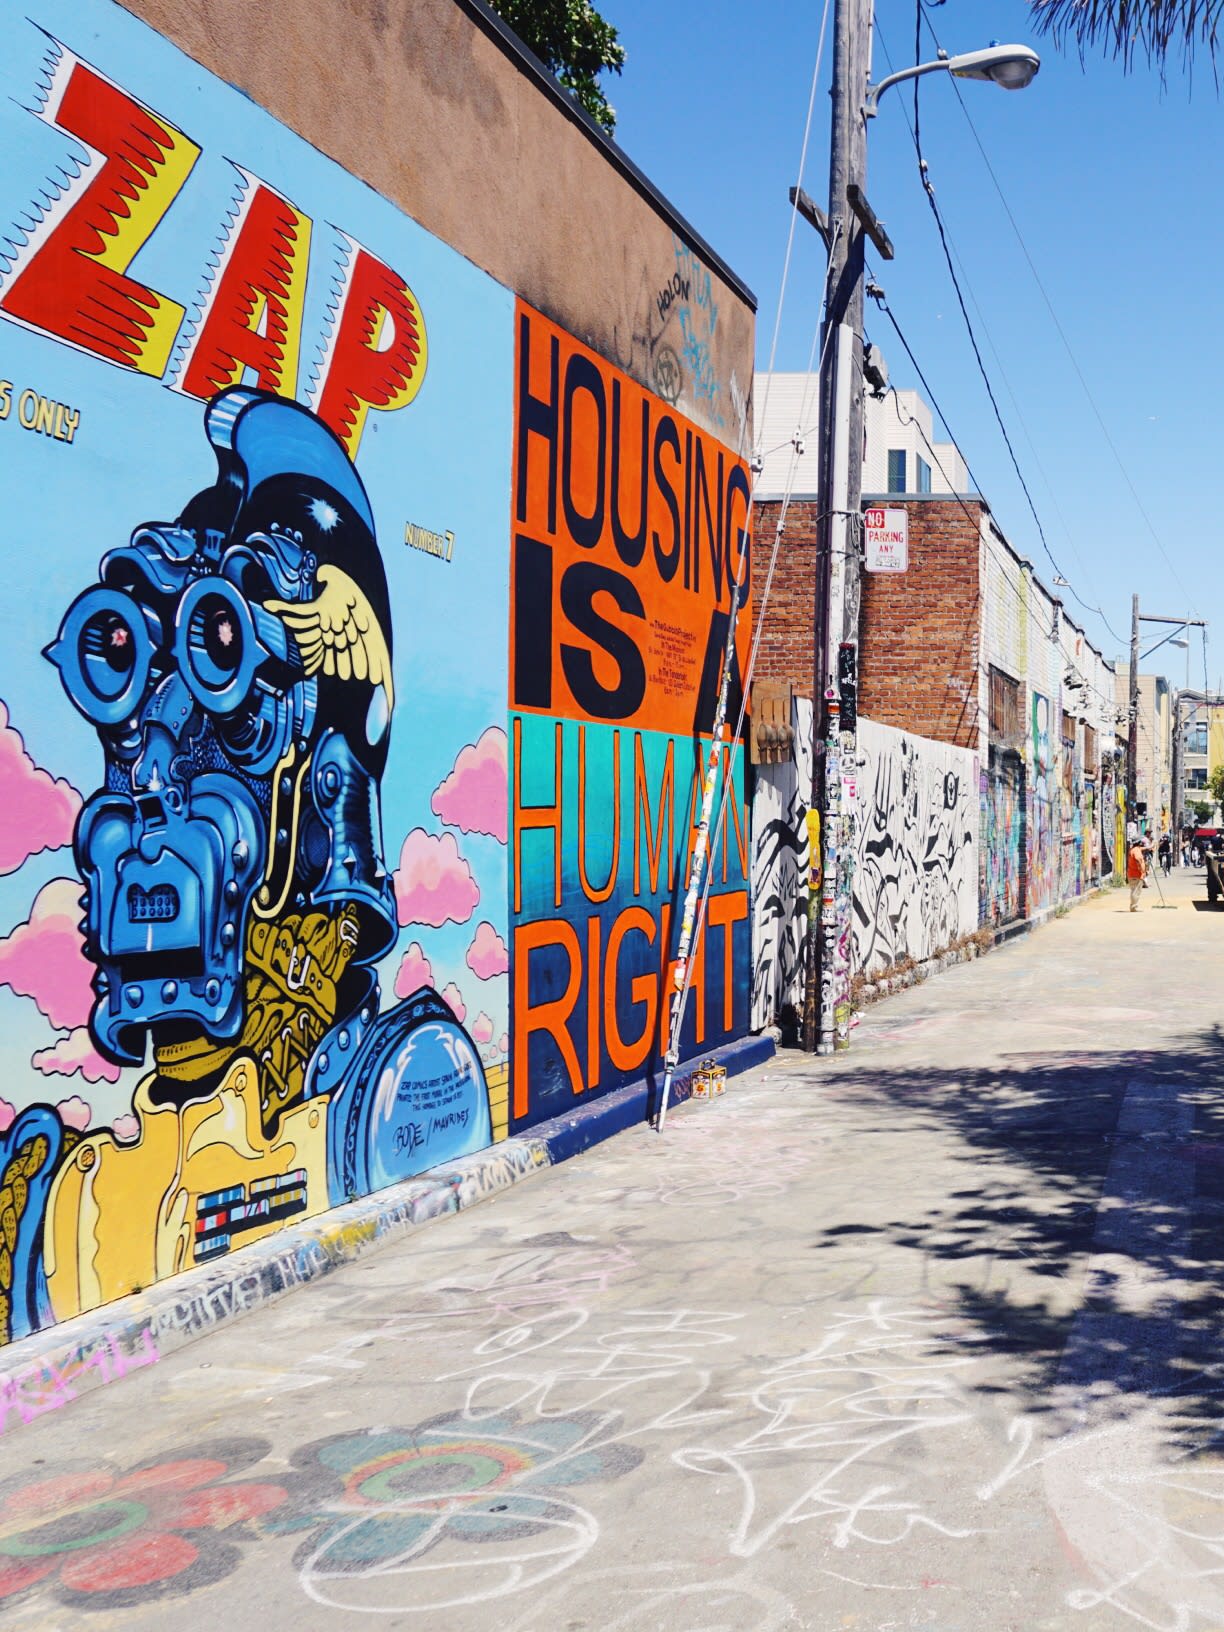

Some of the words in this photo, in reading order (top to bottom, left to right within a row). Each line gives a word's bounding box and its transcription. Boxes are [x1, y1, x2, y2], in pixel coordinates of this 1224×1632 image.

[0, 58, 429, 463] ZAP
[657, 271, 690, 321] HOLON
[18, 388, 81, 445] ONLY
[517, 311, 753, 603] HOUSING
[405, 521, 444, 561] NUMBER
[445, 529, 455, 563] 7
[867, 511, 882, 527] NO
[869, 530, 904, 543] PARKING
[879, 545, 894, 553] ANY
[514, 542, 647, 720] IS
[694, 603, 752, 742] A
[512, 715, 749, 915] HUMAN
[513, 892, 749, 1119] RIGHT
